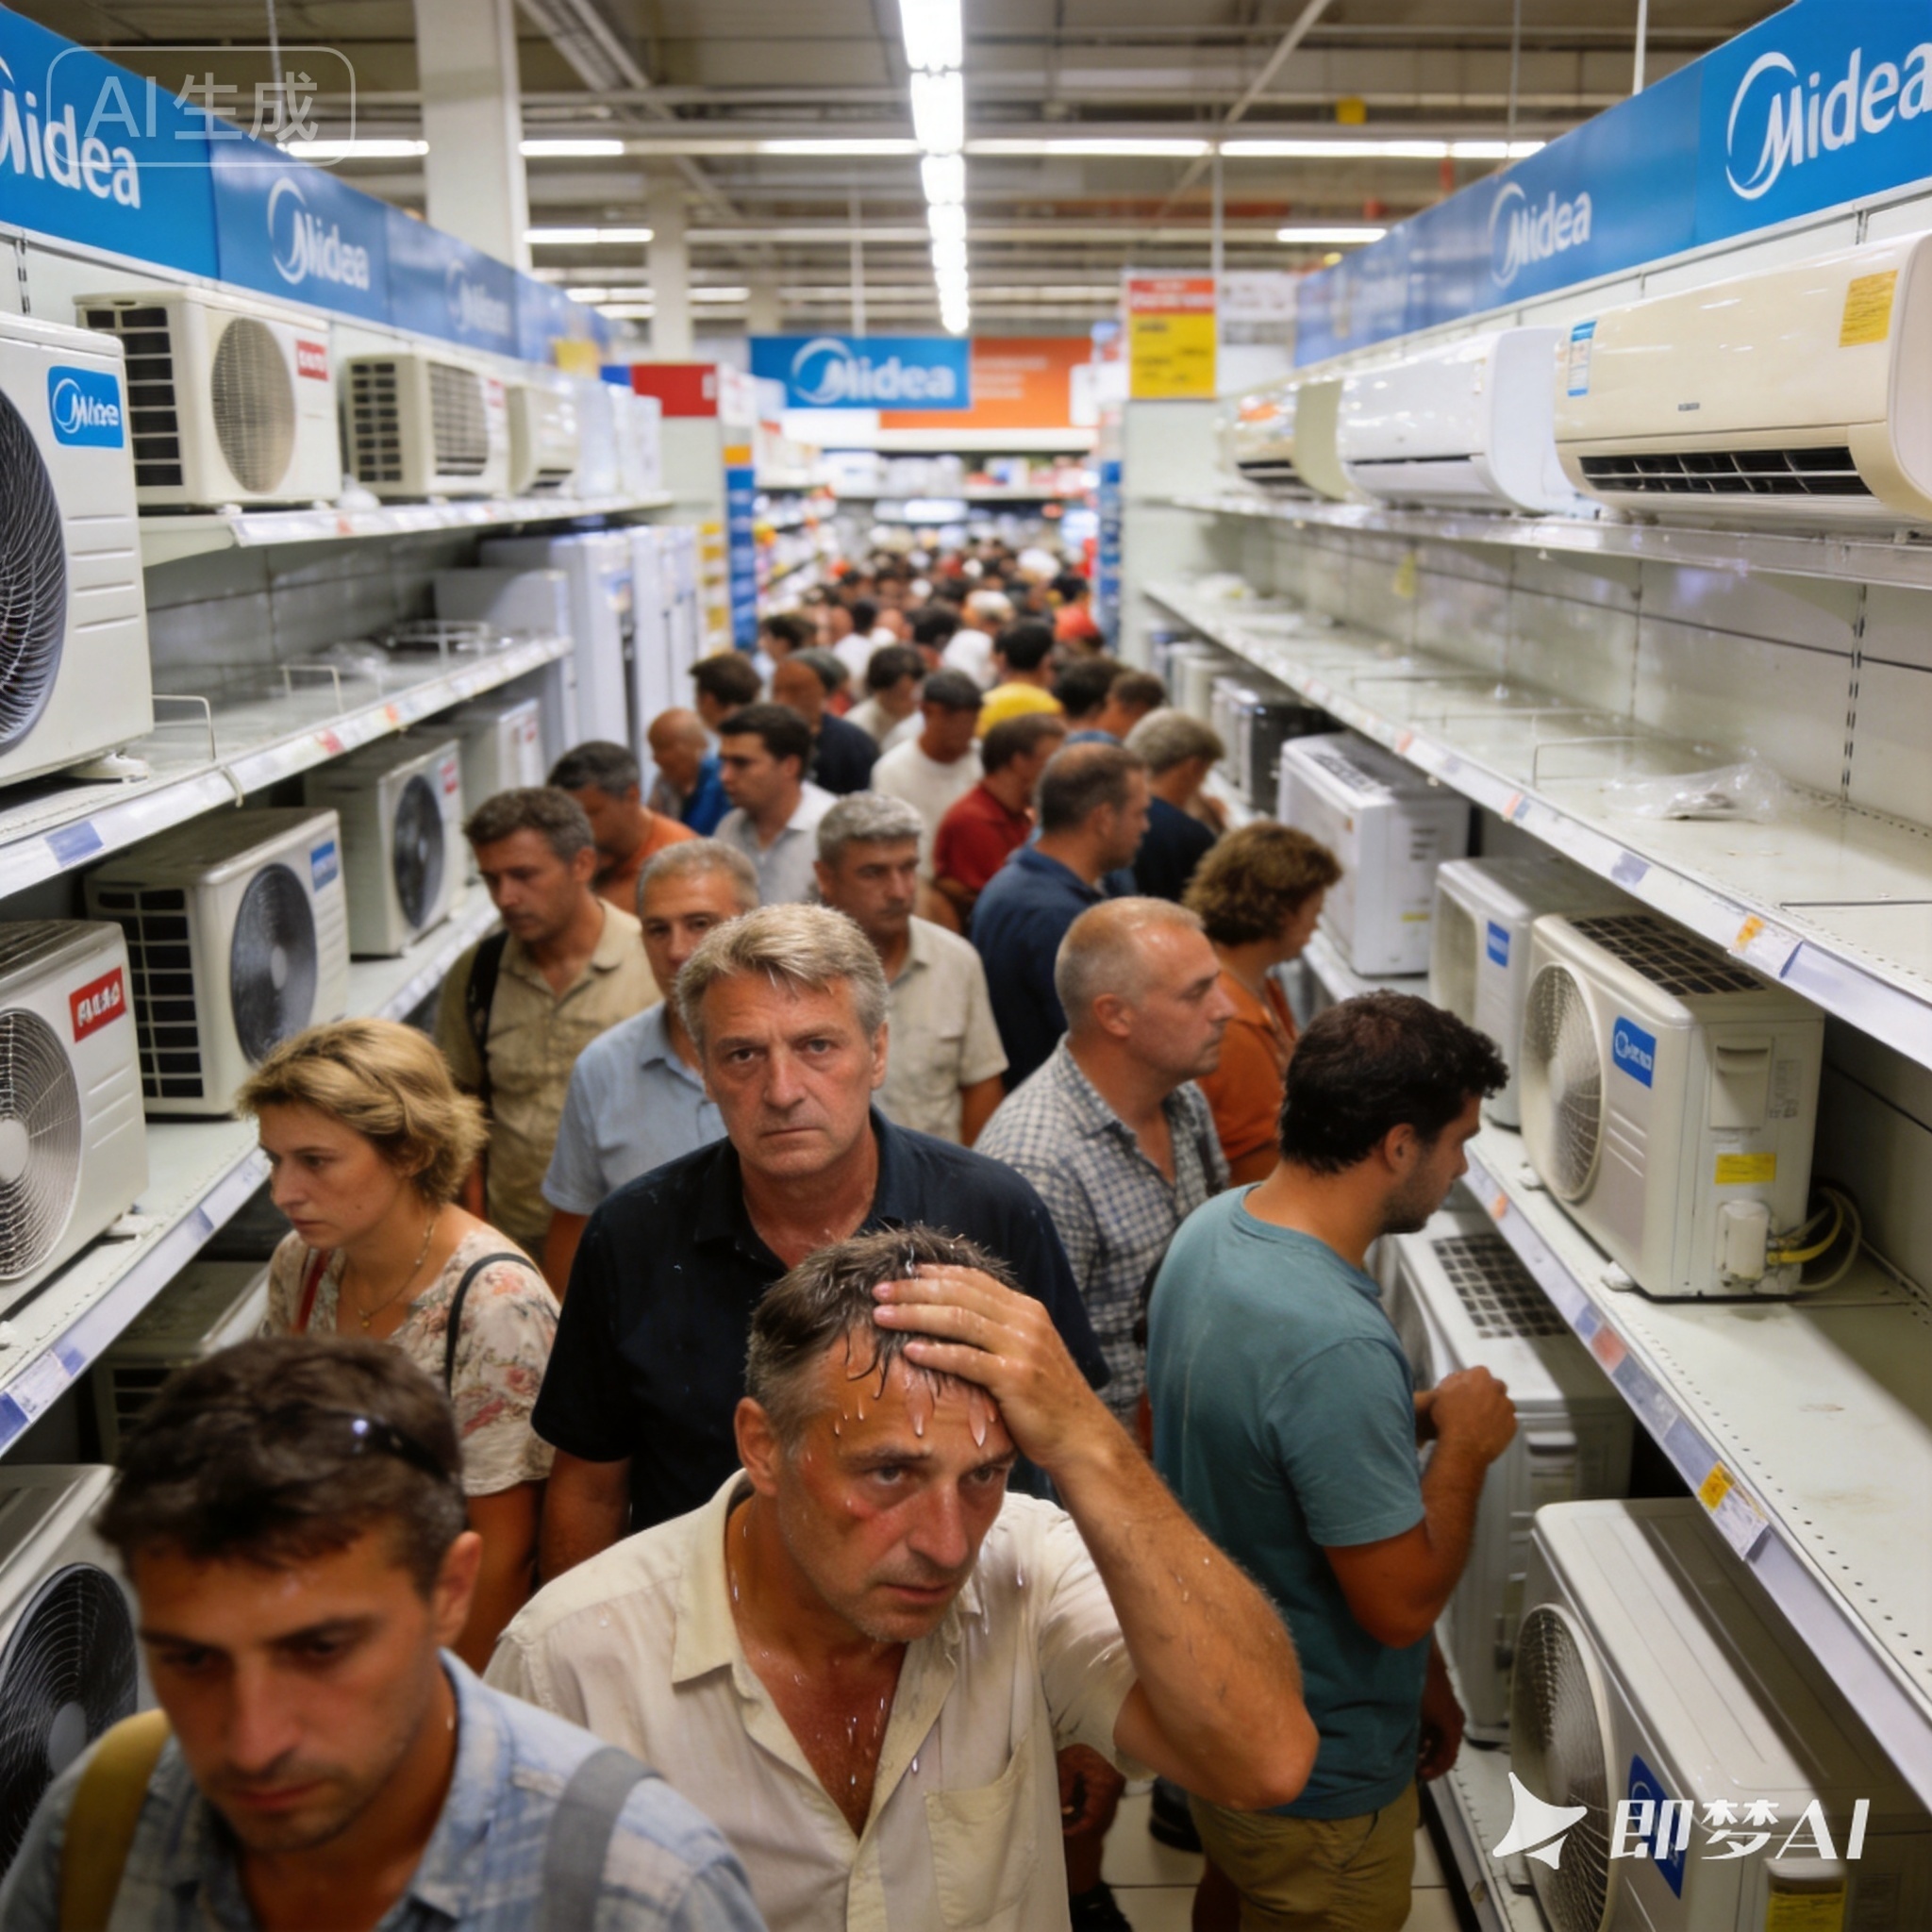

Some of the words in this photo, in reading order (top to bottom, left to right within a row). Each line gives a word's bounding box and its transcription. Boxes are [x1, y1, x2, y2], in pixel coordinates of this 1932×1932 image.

[1726, 42, 1932, 200] Midea
[1489, 182, 1592, 289] Midea
[791, 337, 957, 405] Midea
